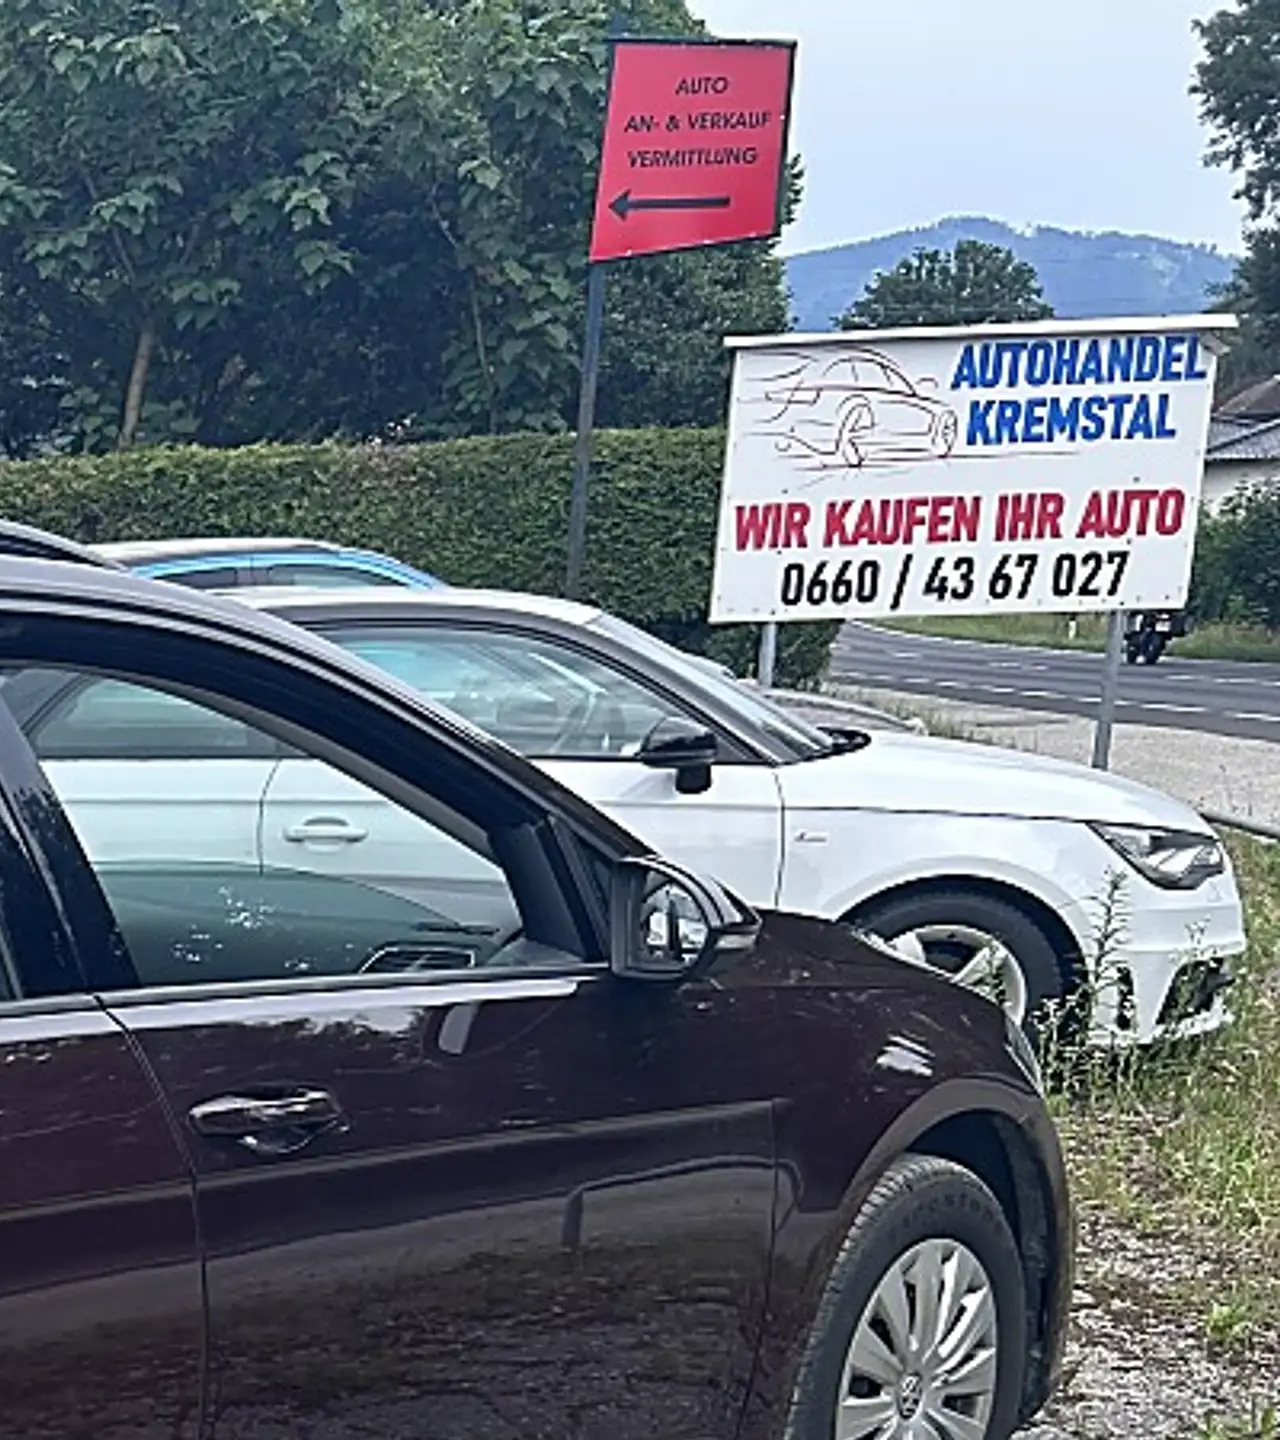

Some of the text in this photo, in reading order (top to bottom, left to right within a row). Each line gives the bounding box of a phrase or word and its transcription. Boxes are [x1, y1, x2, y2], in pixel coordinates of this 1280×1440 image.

[675, 76, 729, 95] AUTO
[624, 111, 772, 133] AN- & VERKAUF
[628, 147, 758, 168] VERMITTLUNG
[951, 336, 1207, 389] AUTOHANDEL
[966, 394, 1176, 446] KREMSTAL
[735, 489, 1186, 551] WIR KAUFEN IHR AUTO
[781, 560, 880, 606] 0660
[923, 556, 975, 602] 43
[988, 554, 1038, 599] 67
[1052, 550, 1130, 598] 027
